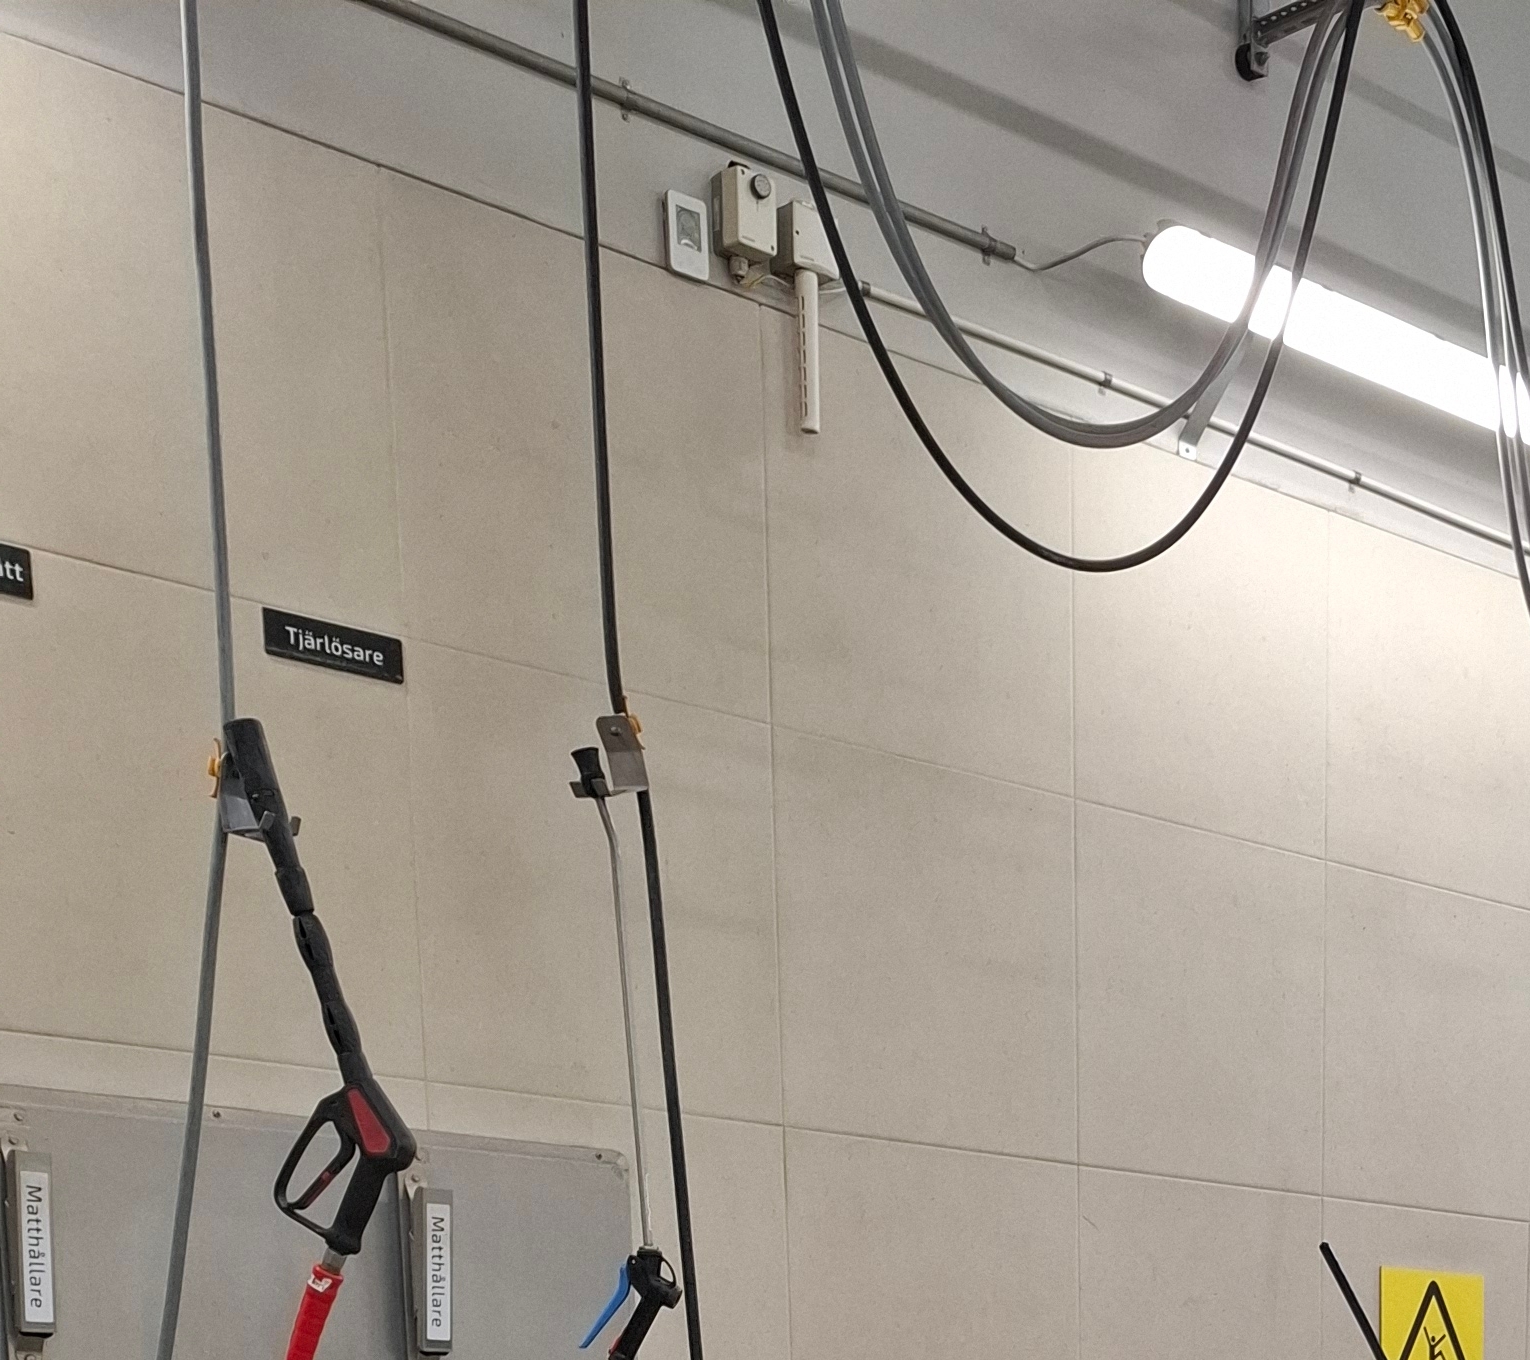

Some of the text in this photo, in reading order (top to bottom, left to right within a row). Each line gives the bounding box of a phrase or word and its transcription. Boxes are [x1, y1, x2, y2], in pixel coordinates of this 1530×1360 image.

[284, 625, 384, 666] Tjärlösare
[25, 1184, 46, 1309] Matthållare
[431, 1216, 446, 1328] Matthållare
